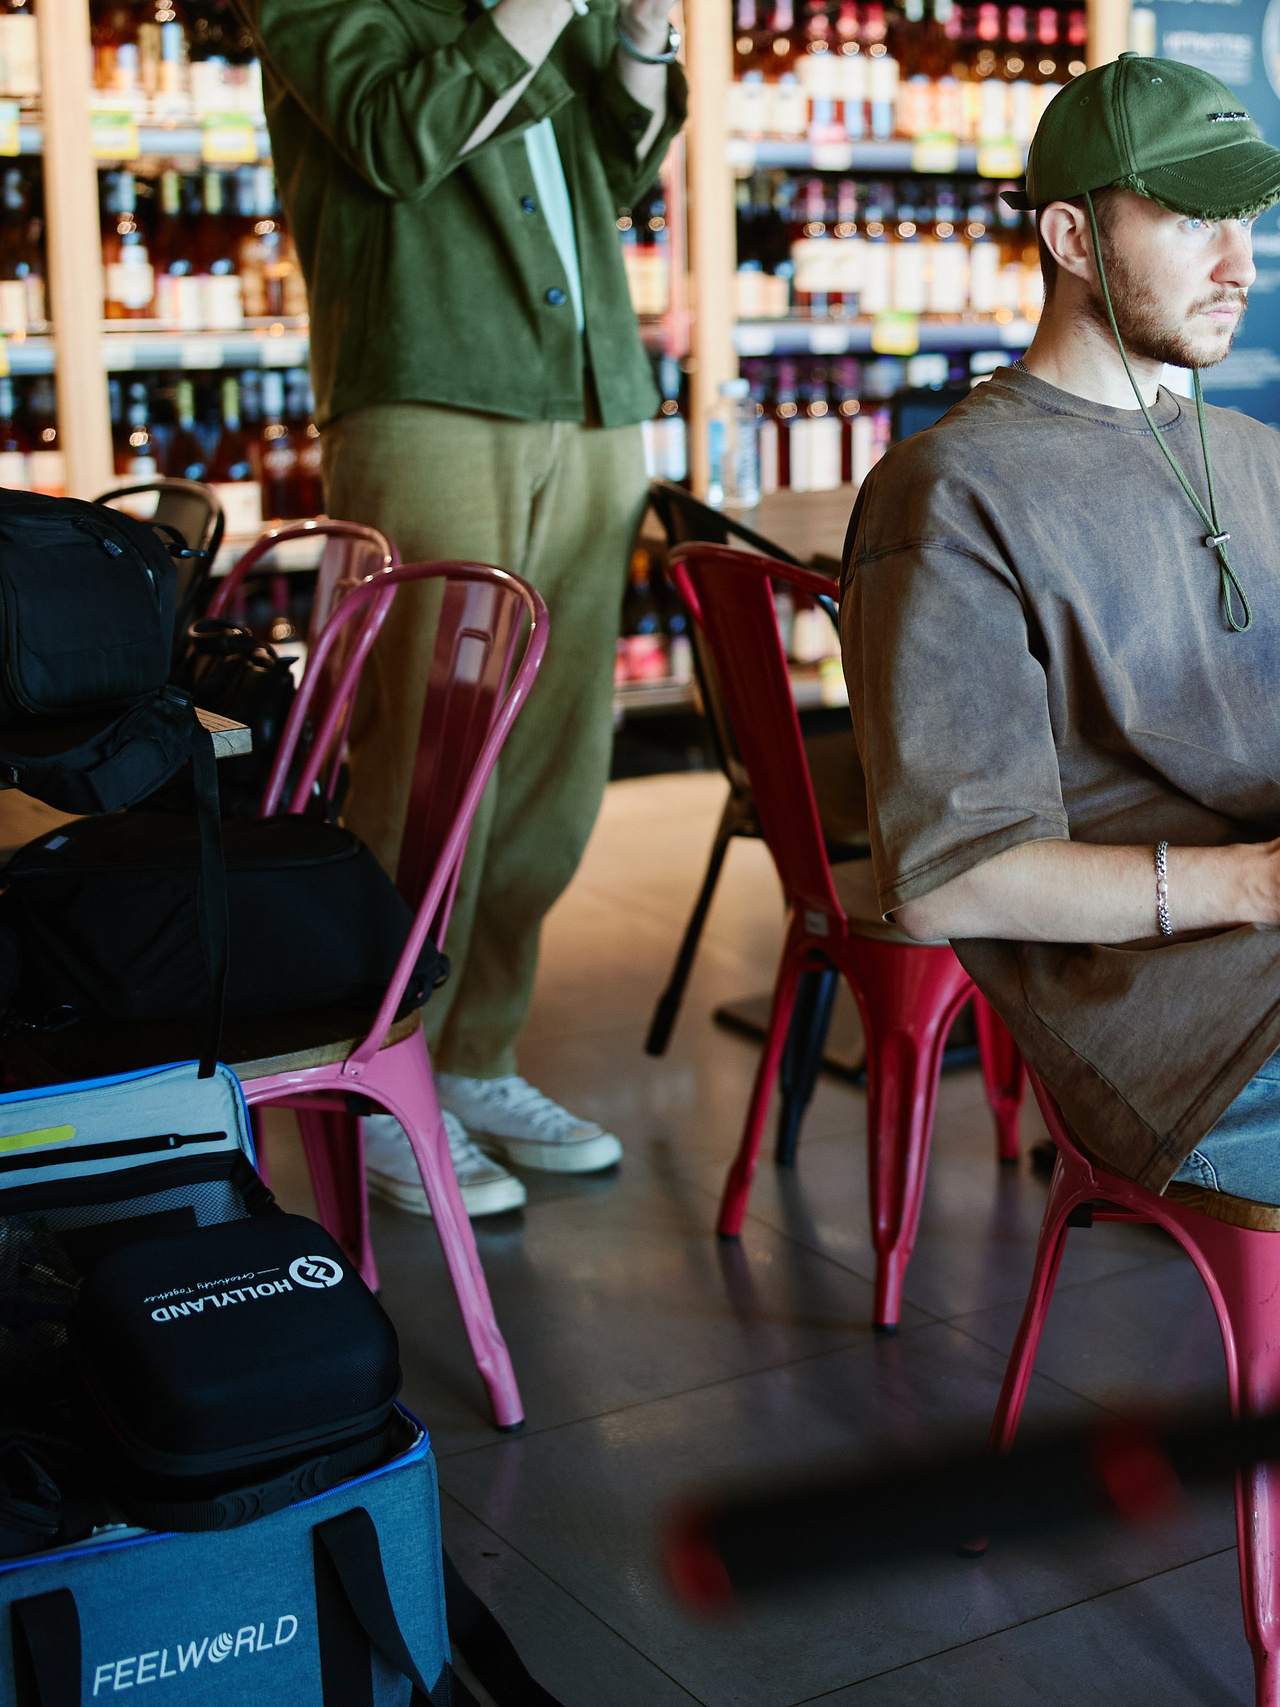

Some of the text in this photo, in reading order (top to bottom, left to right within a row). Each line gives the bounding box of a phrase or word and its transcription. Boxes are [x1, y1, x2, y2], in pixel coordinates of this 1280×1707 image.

[143, 1271, 255, 1303] Creativity Together
[151, 1278, 294, 1322] HOLLYLAND
[93, 1614, 298, 1696] FEELWORLD
